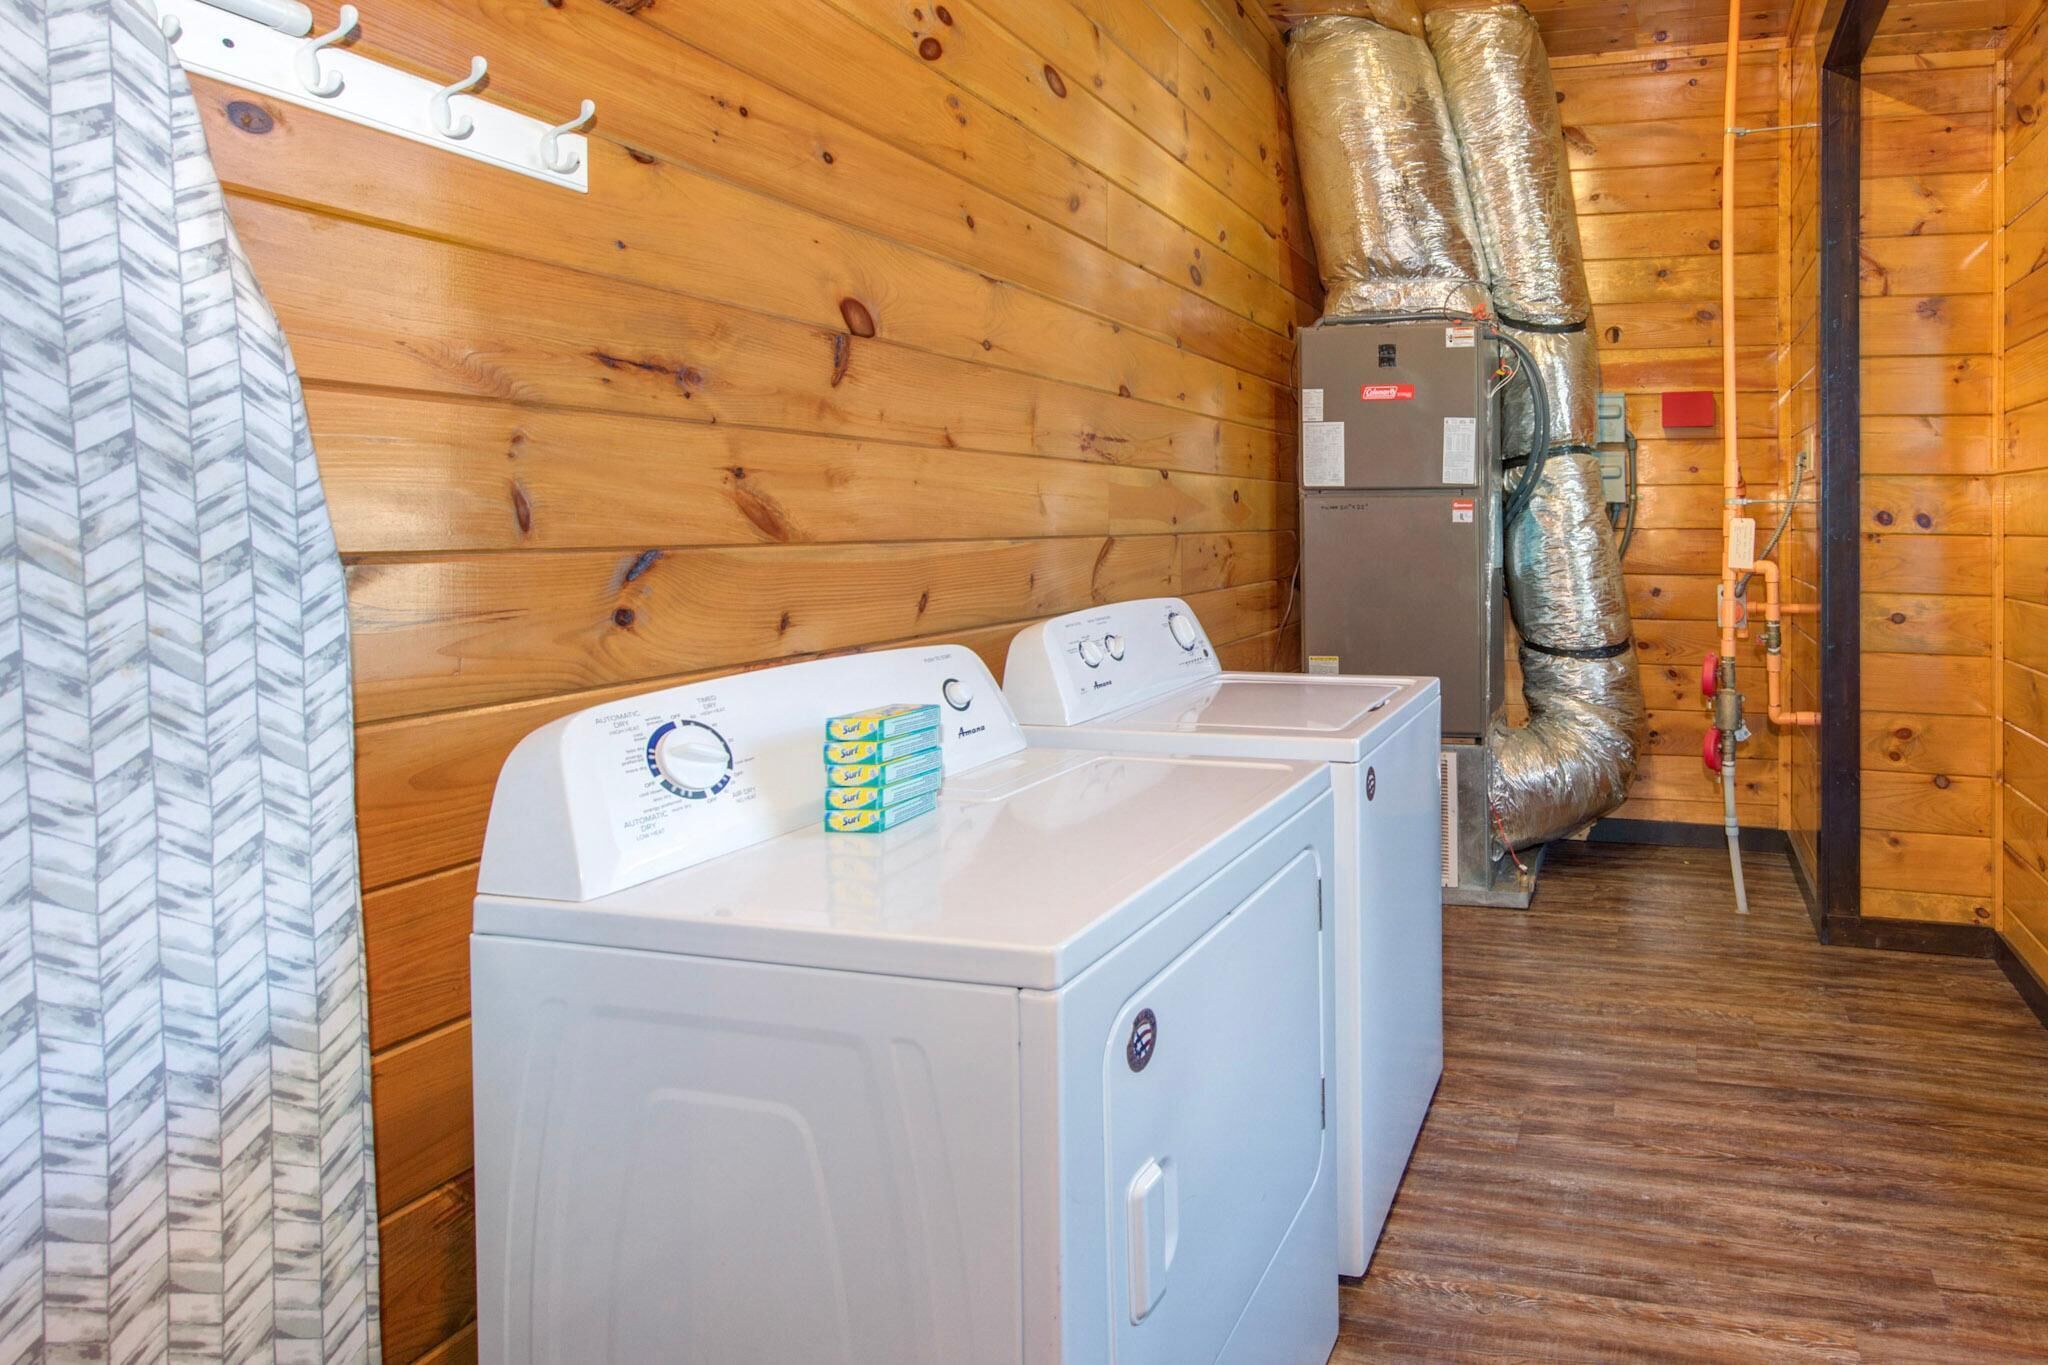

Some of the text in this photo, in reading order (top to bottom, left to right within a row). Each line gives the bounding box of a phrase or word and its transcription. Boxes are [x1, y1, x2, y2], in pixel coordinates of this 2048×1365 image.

[1094, 680, 1112, 690] Amana
[595, 710, 641, 725] AUTOMATIC
[613, 719, 630, 729] DRY
[958, 725, 985, 739] Amana
[624, 810, 668, 828] AUTOMATIC
[640, 822, 656, 832] DRY
